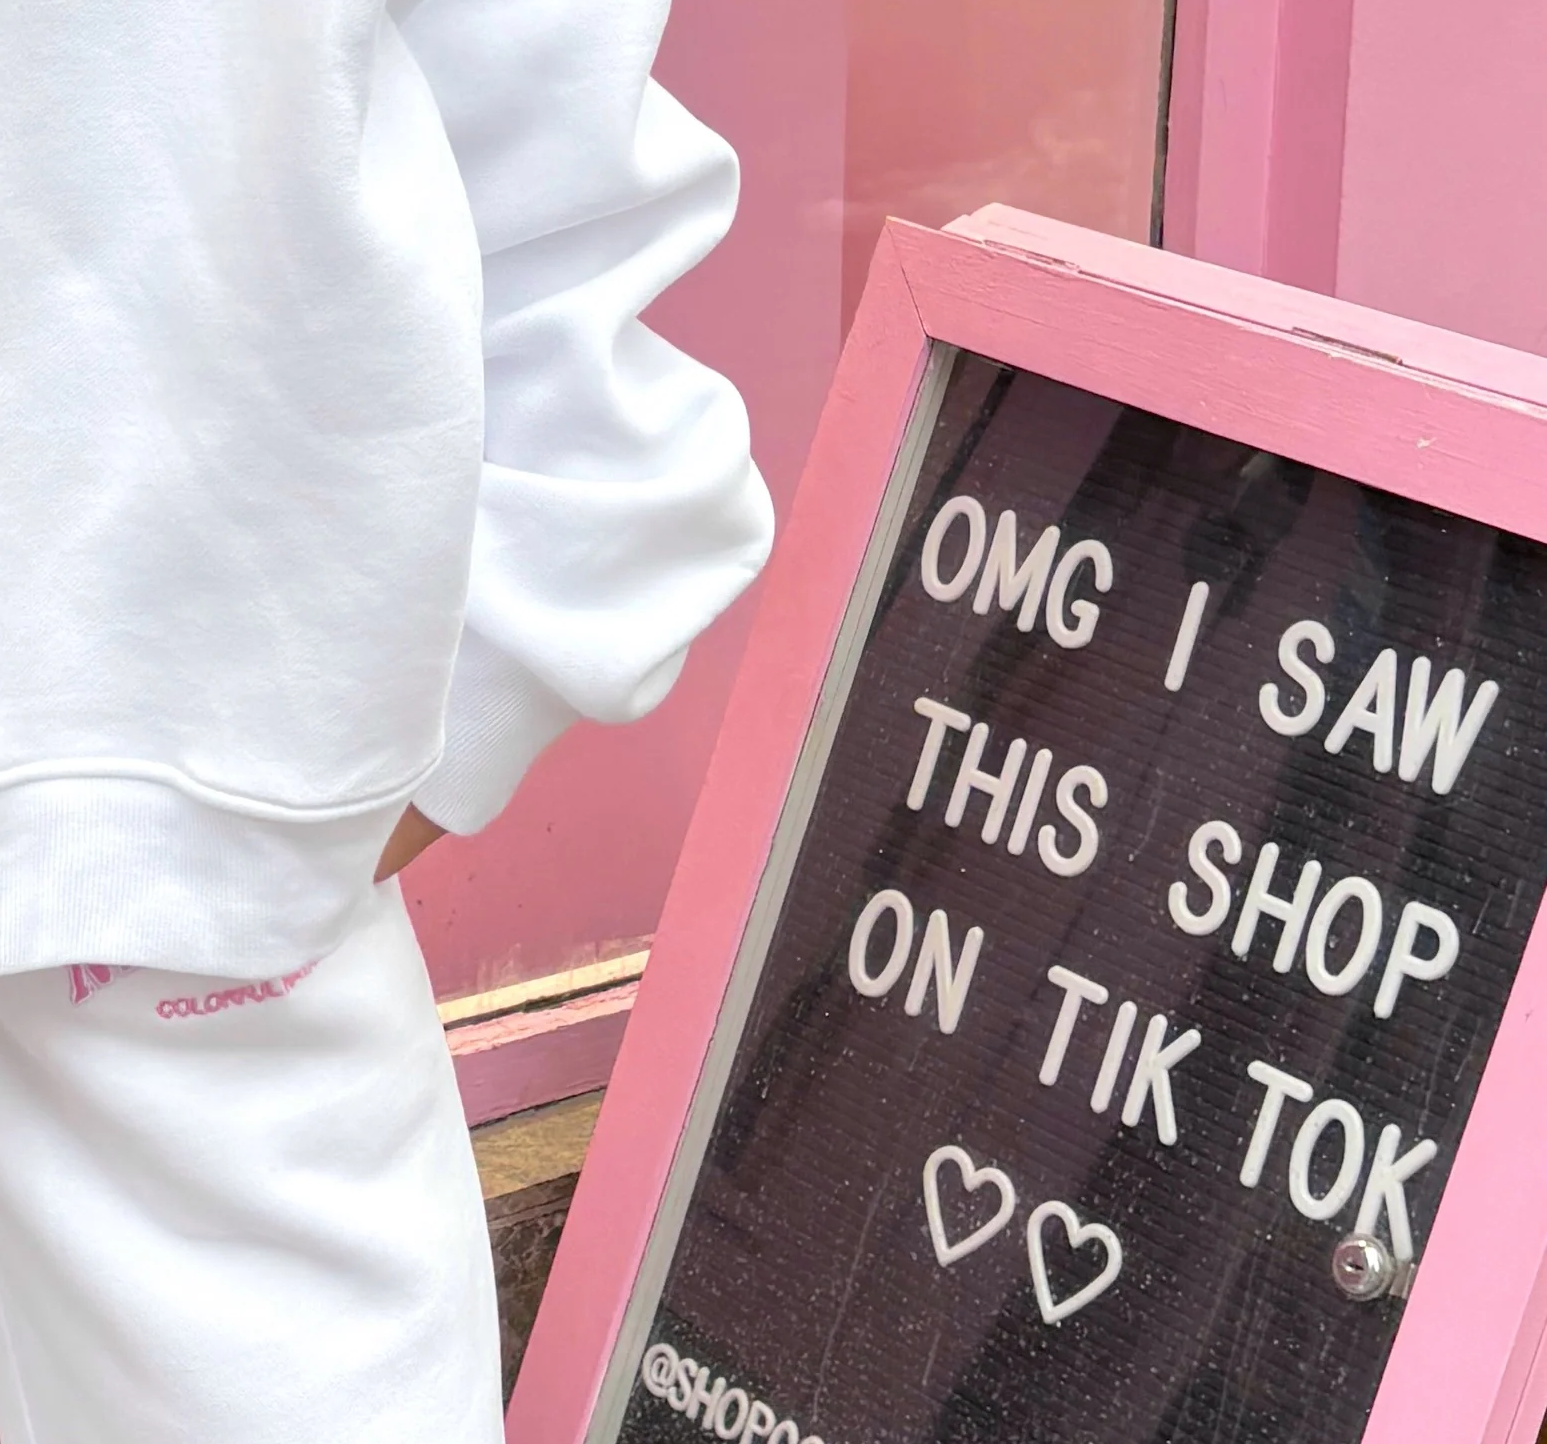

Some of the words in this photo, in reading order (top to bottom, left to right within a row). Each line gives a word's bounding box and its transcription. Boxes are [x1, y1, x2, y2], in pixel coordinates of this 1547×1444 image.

[920, 495, 1114, 649] OMG
[1164, 580, 1209, 691] I
[1257, 619, 1499, 795] SAW
[906, 696, 1109, 877] THIS
[1167, 820, 1460, 1019] SHOP
[847, 888, 985, 1034] ON
[1037, 964, 1202, 1146] TIK
[1238, 1059, 1438, 1265] TOK
